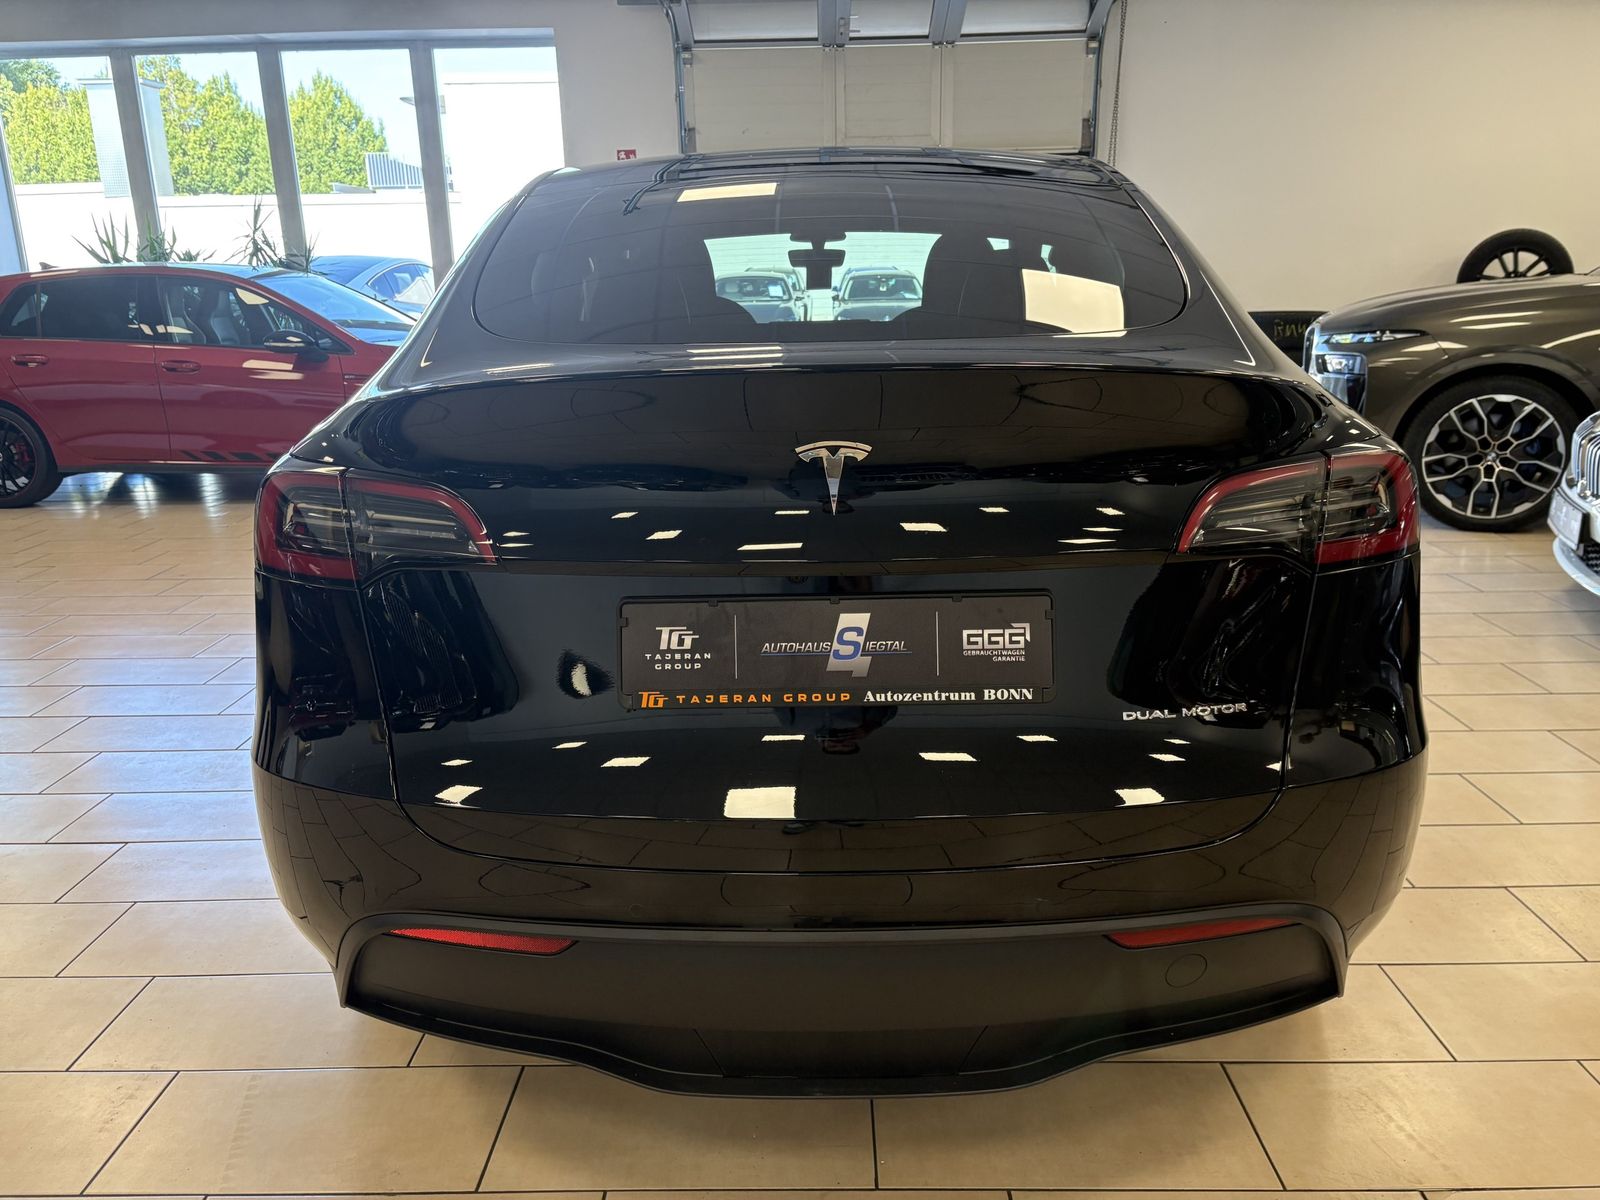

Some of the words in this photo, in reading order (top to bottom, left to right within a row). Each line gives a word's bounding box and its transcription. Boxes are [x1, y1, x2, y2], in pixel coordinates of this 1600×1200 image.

[655, 626, 700, 650] TG
[761, 641, 832, 653] AUTOHAUS
[962, 628, 1025, 649] GGG
[638, 691, 669, 708] TG
[676, 693, 772, 704] TAJERAN
[783, 692, 851, 703] GROUP
[863, 690, 976, 702] Autozentrum
[983, 688, 1033, 701] BONN
[1122, 709, 1177, 721] DUAL
[1181, 702, 1248, 718] MOTOR
